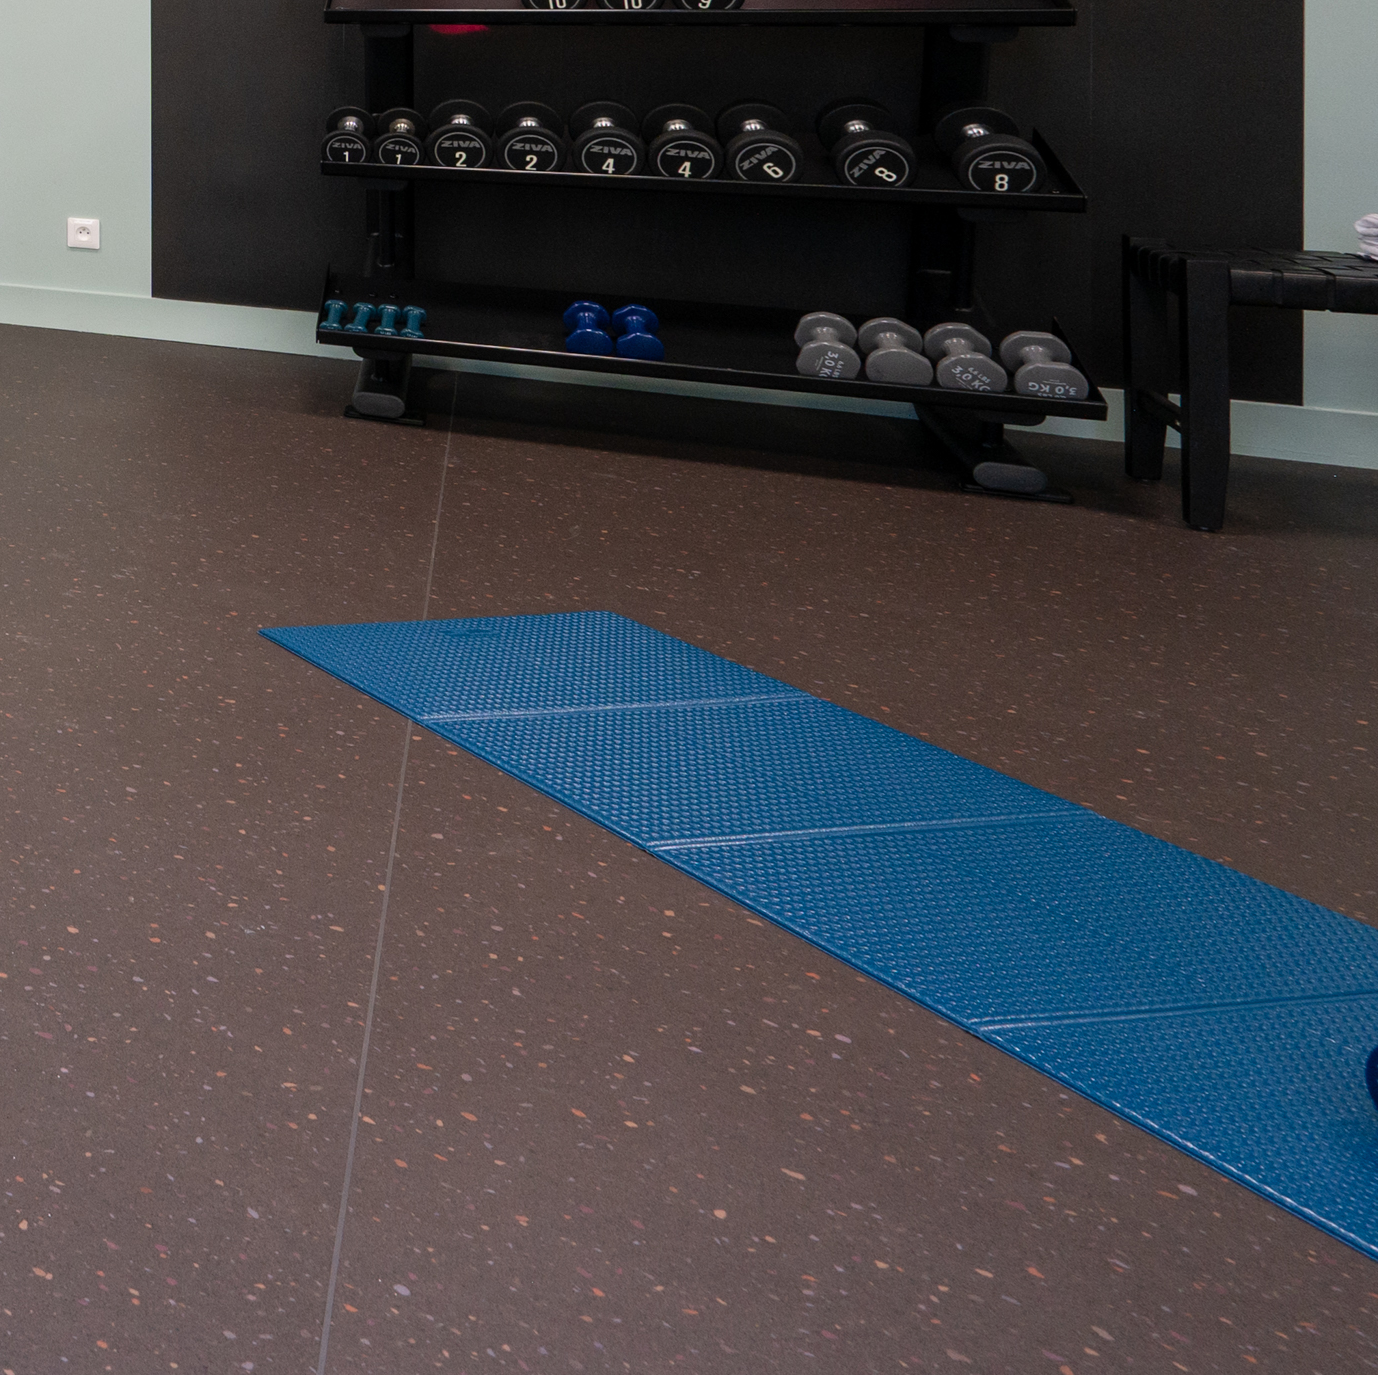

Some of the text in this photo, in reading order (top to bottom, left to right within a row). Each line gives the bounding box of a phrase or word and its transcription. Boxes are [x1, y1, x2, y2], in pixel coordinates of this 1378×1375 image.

[332, 141, 363, 150] ZIVA
[384, 143, 417, 154] ZIVA
[440, 140, 481, 149] ZIVA
[511, 142, 554, 153] ZIVA
[589, 145, 633, 157] ZIVA
[342, 150, 350, 163] 1
[394, 153, 402, 165] 1
[454, 151, 467, 167] 2
[665, 148, 711, 160] ZIVA
[738, 146, 779, 171] ZIVA
[524, 154, 538, 170] 2
[601, 157, 616, 174] 4
[849, 149, 887, 178] ZIVA
[977, 160, 1031, 170] ZIVA
[677, 161, 692, 178] 4
[761, 162, 784, 179] 6
[874, 167, 897, 182] 8
[994, 173, 1009, 192] 8
